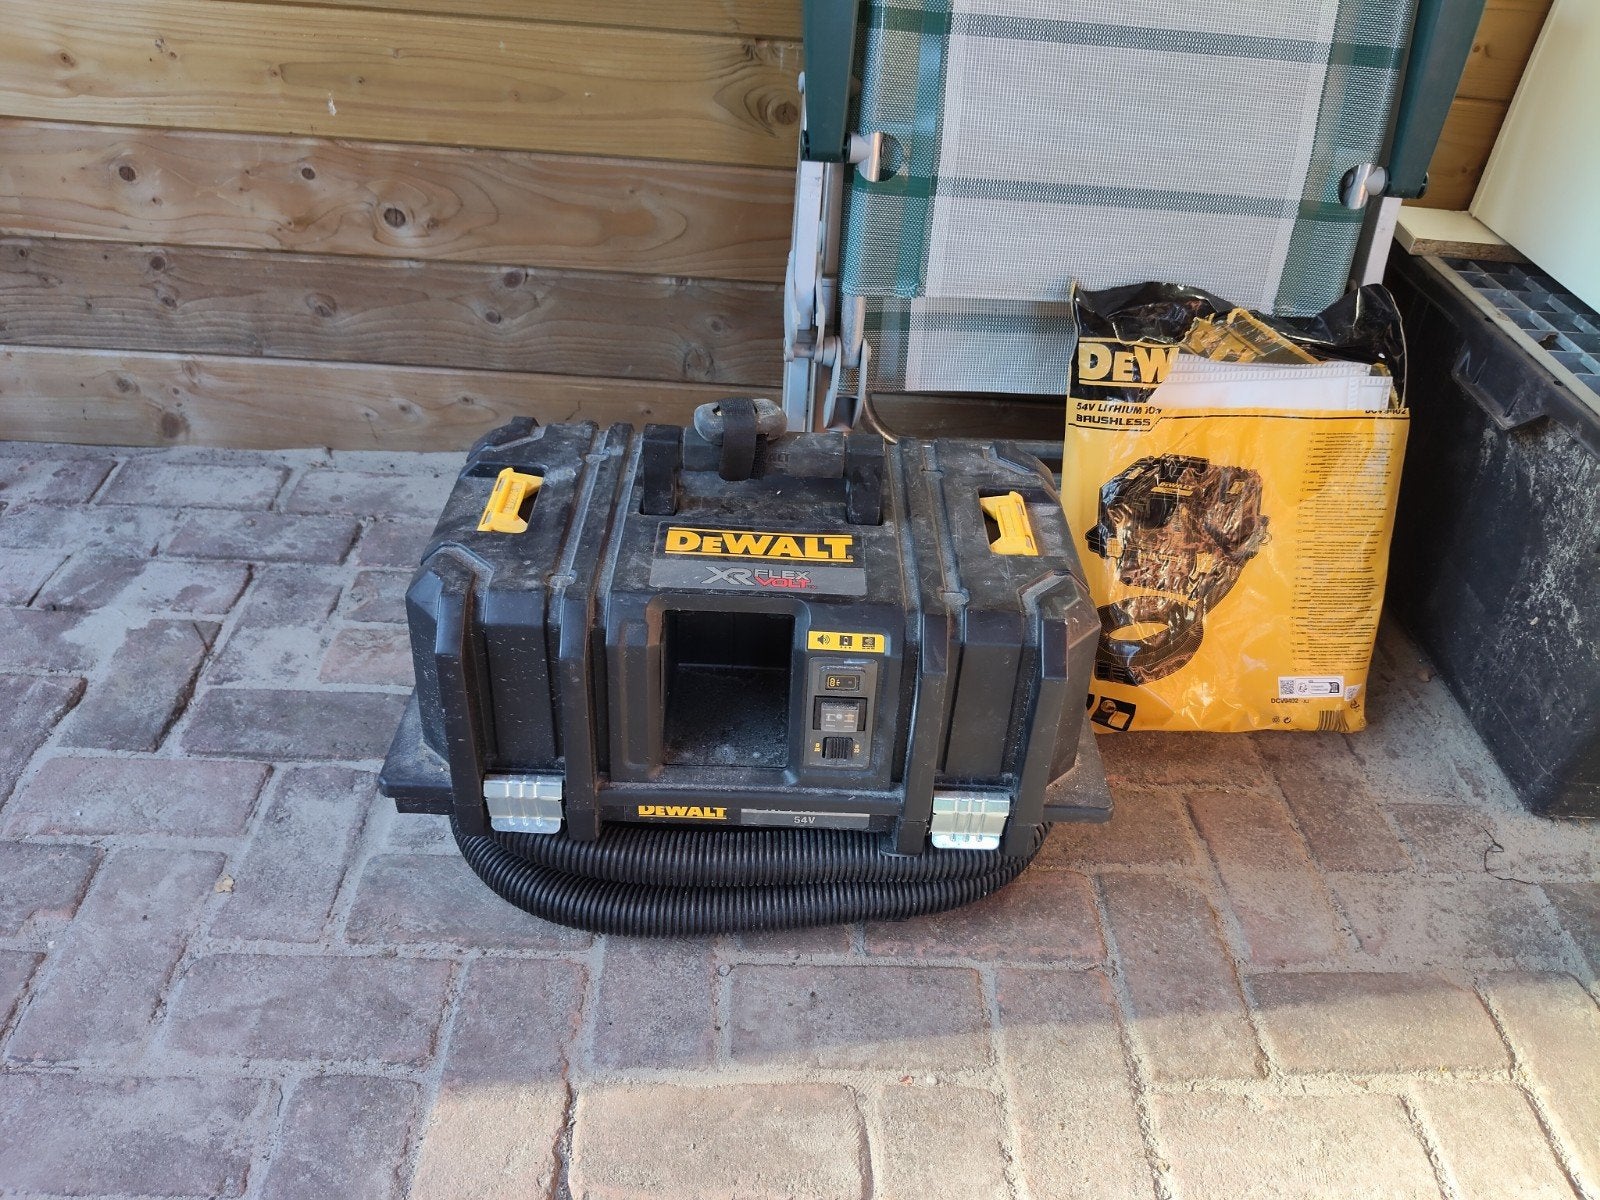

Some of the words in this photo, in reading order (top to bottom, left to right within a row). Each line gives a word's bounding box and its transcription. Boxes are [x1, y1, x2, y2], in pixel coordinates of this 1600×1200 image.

[1076, 402, 1096, 412] 54V
[1098, 403, 1142, 415] LITHIUM
[1076, 413, 1151, 426] BRUSHLESS
[665, 530, 853, 559] DEWALT
[701, 566, 755, 586] XR
[754, 568, 810, 581] FLEX
[755, 576, 811, 589] VOLT
[638, 805, 728, 819] DEWALT
[793, 815, 816, 825] 54V
